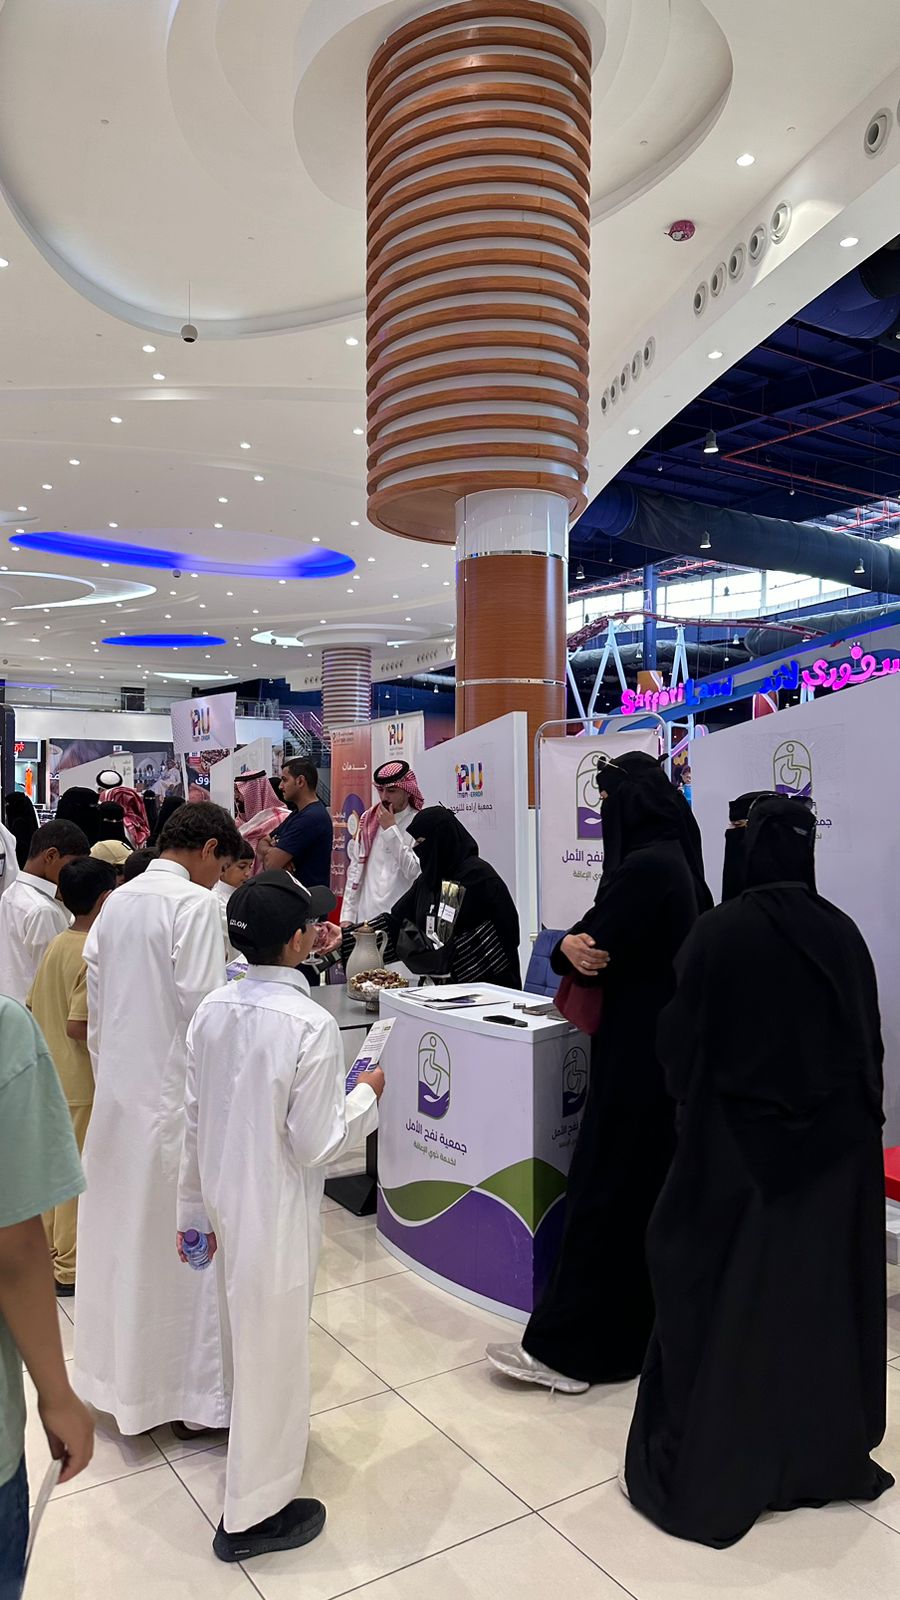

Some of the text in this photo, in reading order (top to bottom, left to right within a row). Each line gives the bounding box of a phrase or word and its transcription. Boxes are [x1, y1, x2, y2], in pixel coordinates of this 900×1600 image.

[621, 674, 734, 714] Saffori Land
[561, 848, 604, 867] نفح الأمل
[405, 1117, 468, 1156] جمعية نفح الأمل
